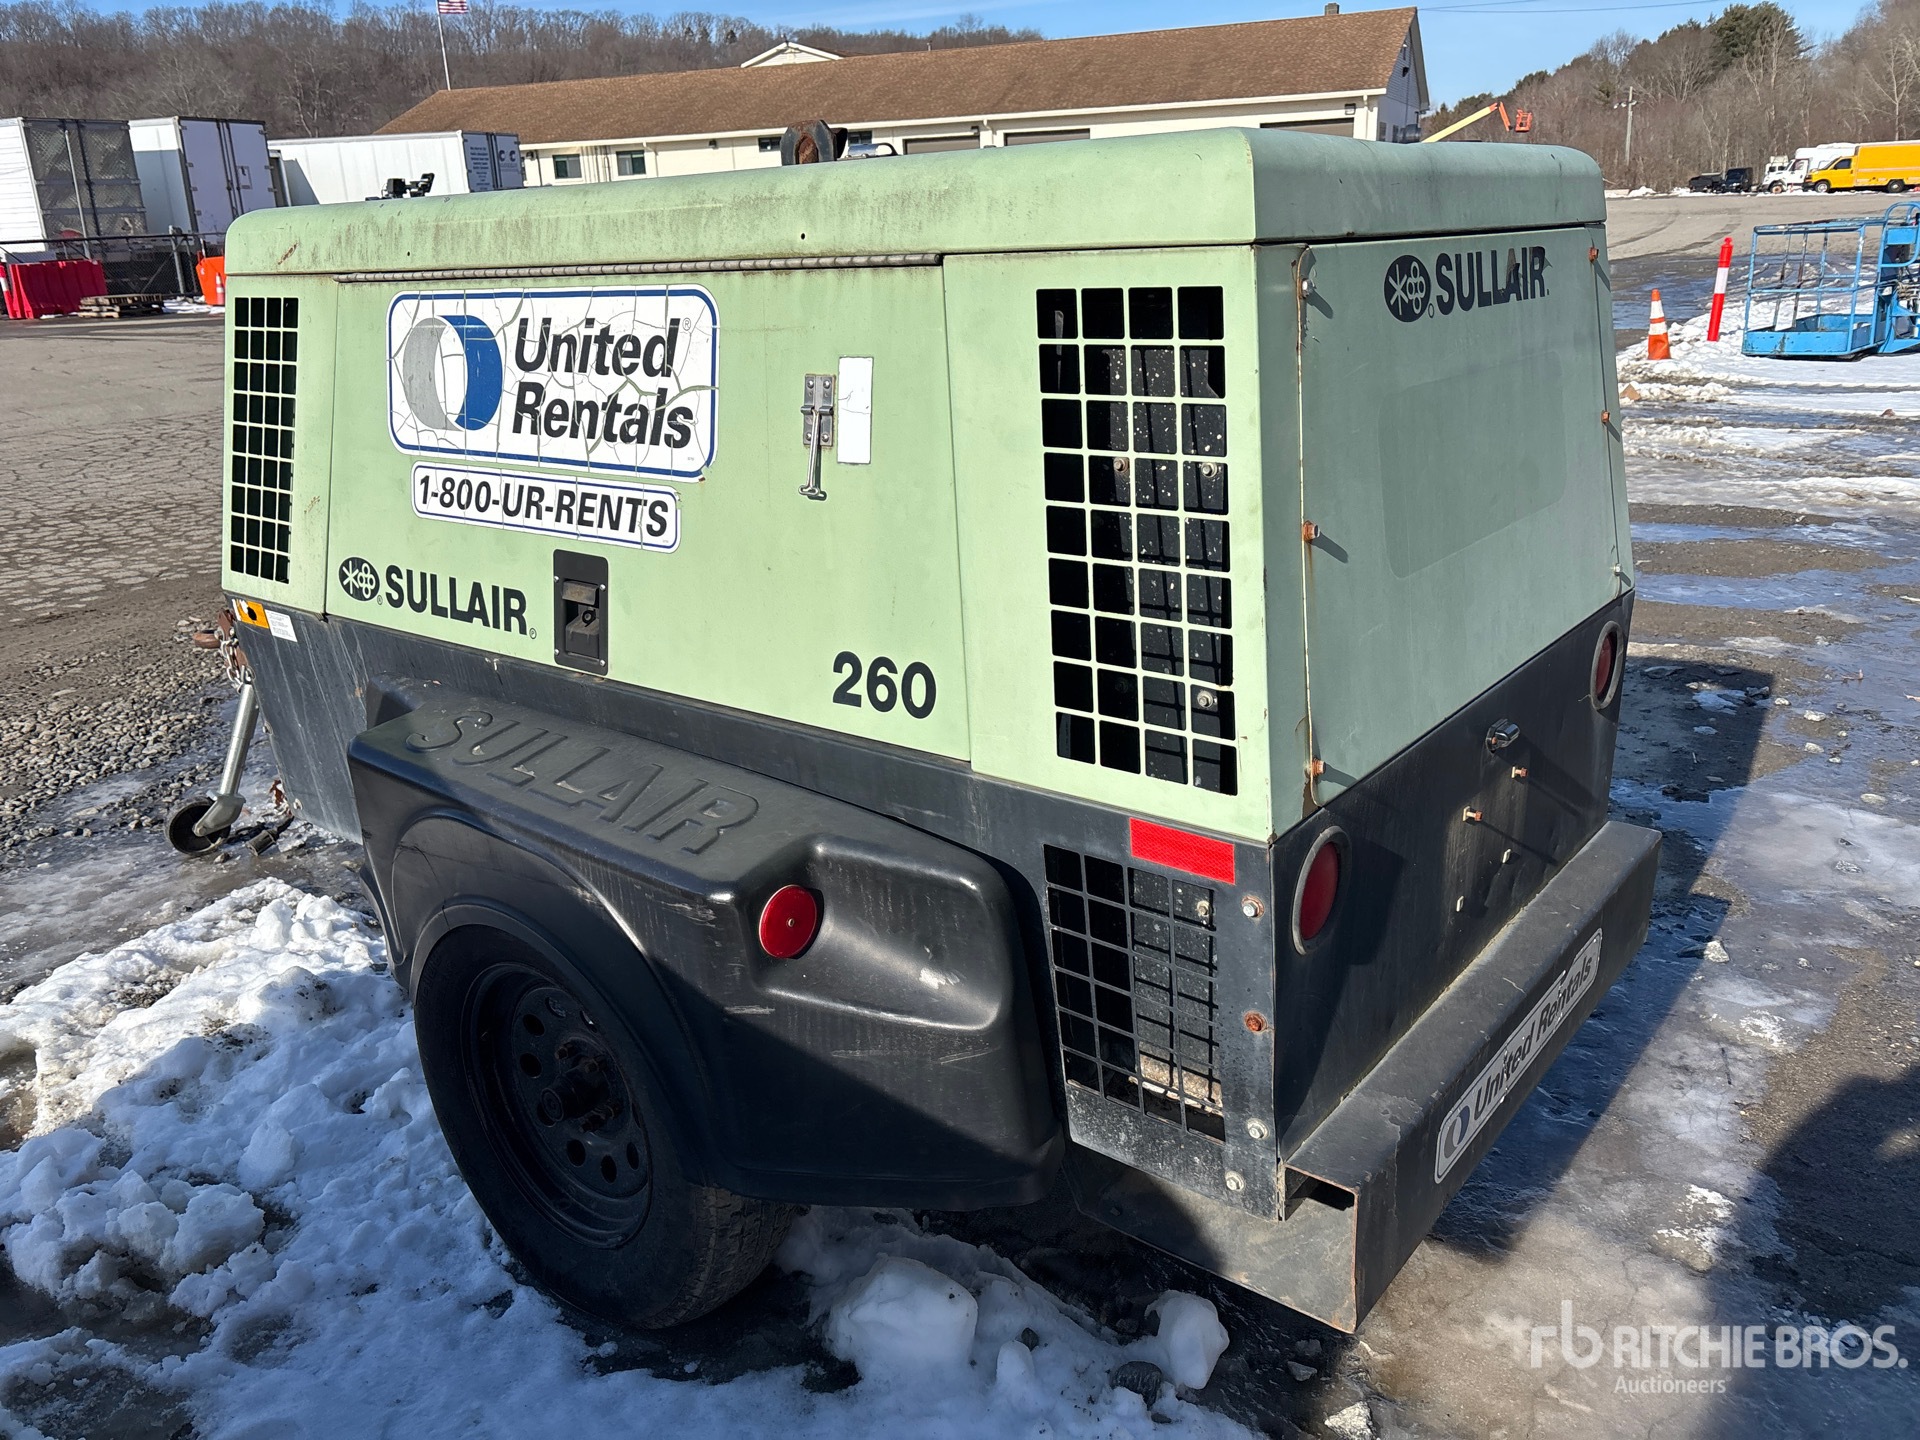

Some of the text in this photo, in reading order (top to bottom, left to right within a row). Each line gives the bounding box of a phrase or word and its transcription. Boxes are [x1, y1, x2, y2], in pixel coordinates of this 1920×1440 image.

[1435, 246, 1546, 315] SULLAIR
[514, 317, 681, 377] United
[512, 381, 694, 449] Rentals
[418, 474, 669, 537] 1-800-UR-RENTS
[385, 564, 527, 636] SULLAIR
[833, 650, 937, 719] 260
[405, 711, 759, 854] SULLAIR
[1474, 956, 1592, 1121] United Rentals
